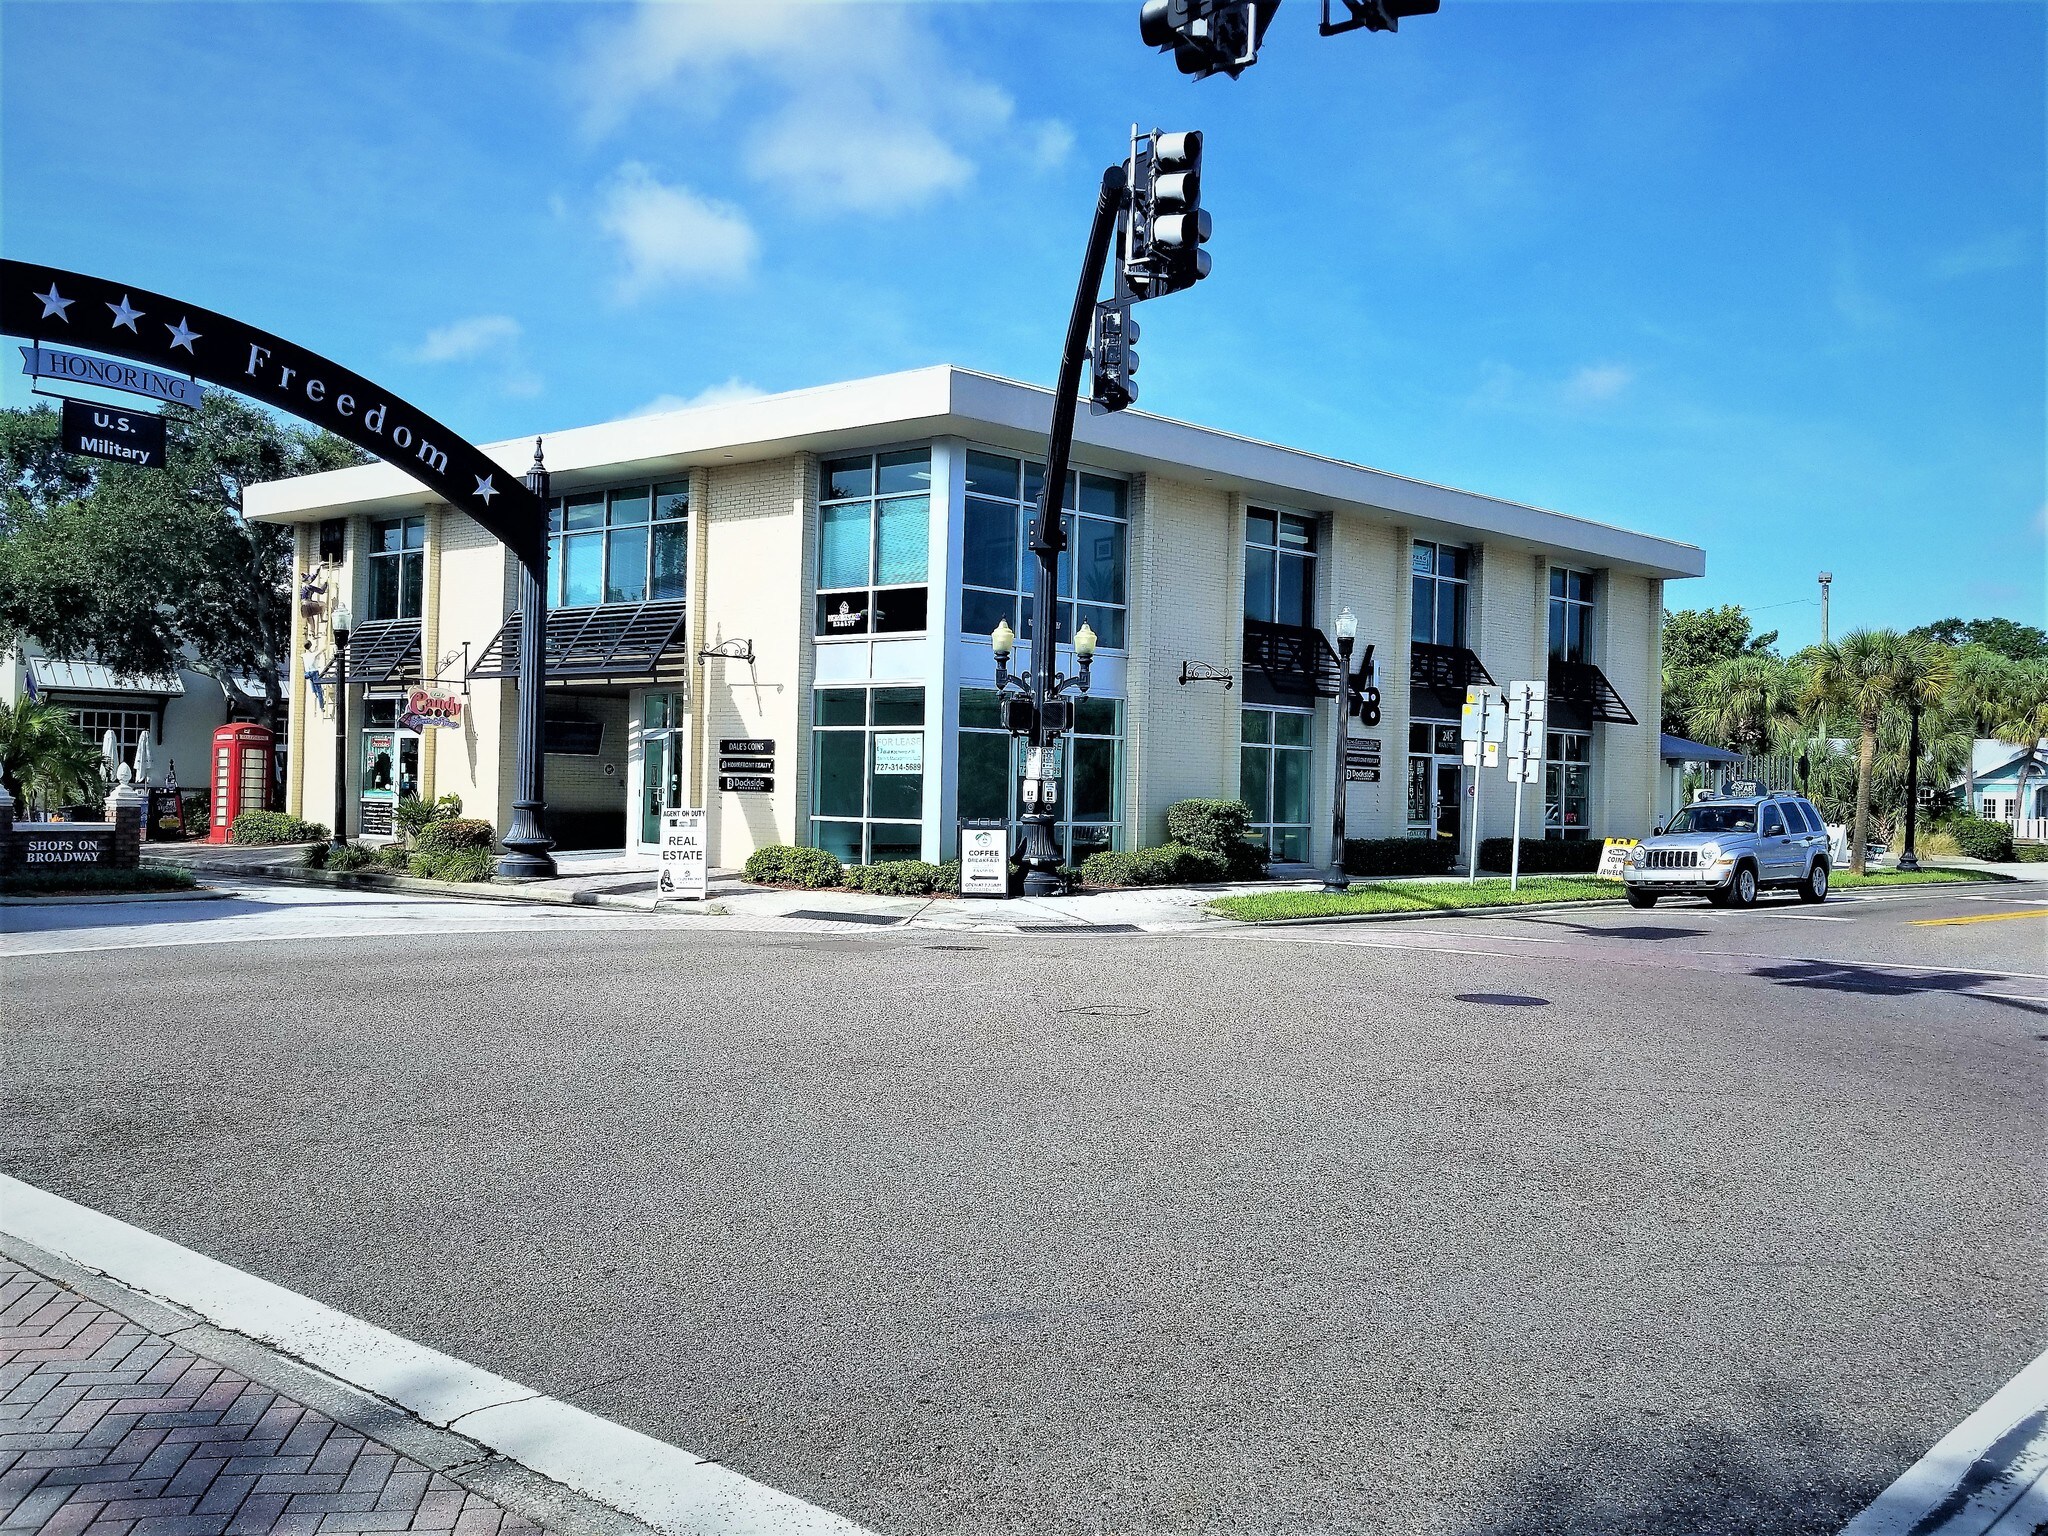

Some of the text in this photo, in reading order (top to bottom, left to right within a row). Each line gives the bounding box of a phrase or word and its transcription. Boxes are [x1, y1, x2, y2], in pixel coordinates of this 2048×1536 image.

[50, 353, 185, 399] HONORING
[245, 342, 450, 475] Freedom
[94, 412, 136, 434] U.S.
[80, 436, 150, 465] Military
[410, 691, 462, 717] Candy
[876, 737, 921, 746] FOR LEASE
[1442, 731, 1455, 742] 245
[728, 742, 765, 751] DALE'S COINS
[1352, 769, 1375, 778] Dockside
[735, 778, 764, 787] Dockside
[28, 840, 98, 851] SHOPS ON
[668, 836, 698, 846] REAL
[26, 852, 100, 862] BROADWAY
[662, 850, 703, 861] ESTATE
